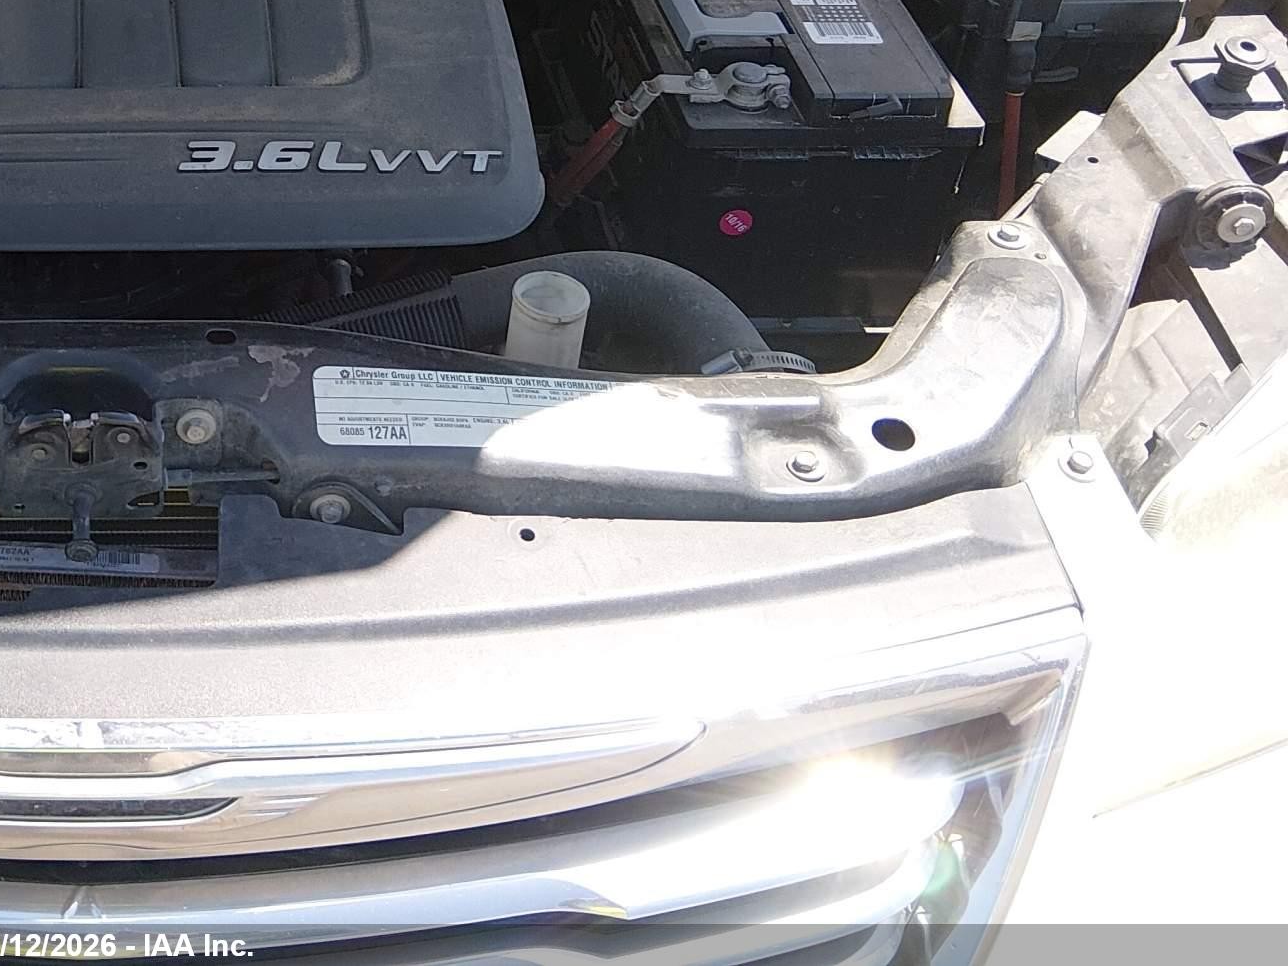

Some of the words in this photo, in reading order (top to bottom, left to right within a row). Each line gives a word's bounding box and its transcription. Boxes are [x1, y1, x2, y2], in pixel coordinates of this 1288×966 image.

[725, 213, 747, 233] 10/16
[355, 370, 388, 380] Chrysler
[391, 371, 416, 381] Group
[417, 373, 434, 381] LLC
[440, 374, 473, 383] VEHICLE
[475, 375, 513, 385] EMISSION
[515, 378, 553, 388] CONTROL
[554, 381, 608, 391] INFORMATION
[339, 427, 365, 436] 68085
[368, 426, 407, 440] 127AA
